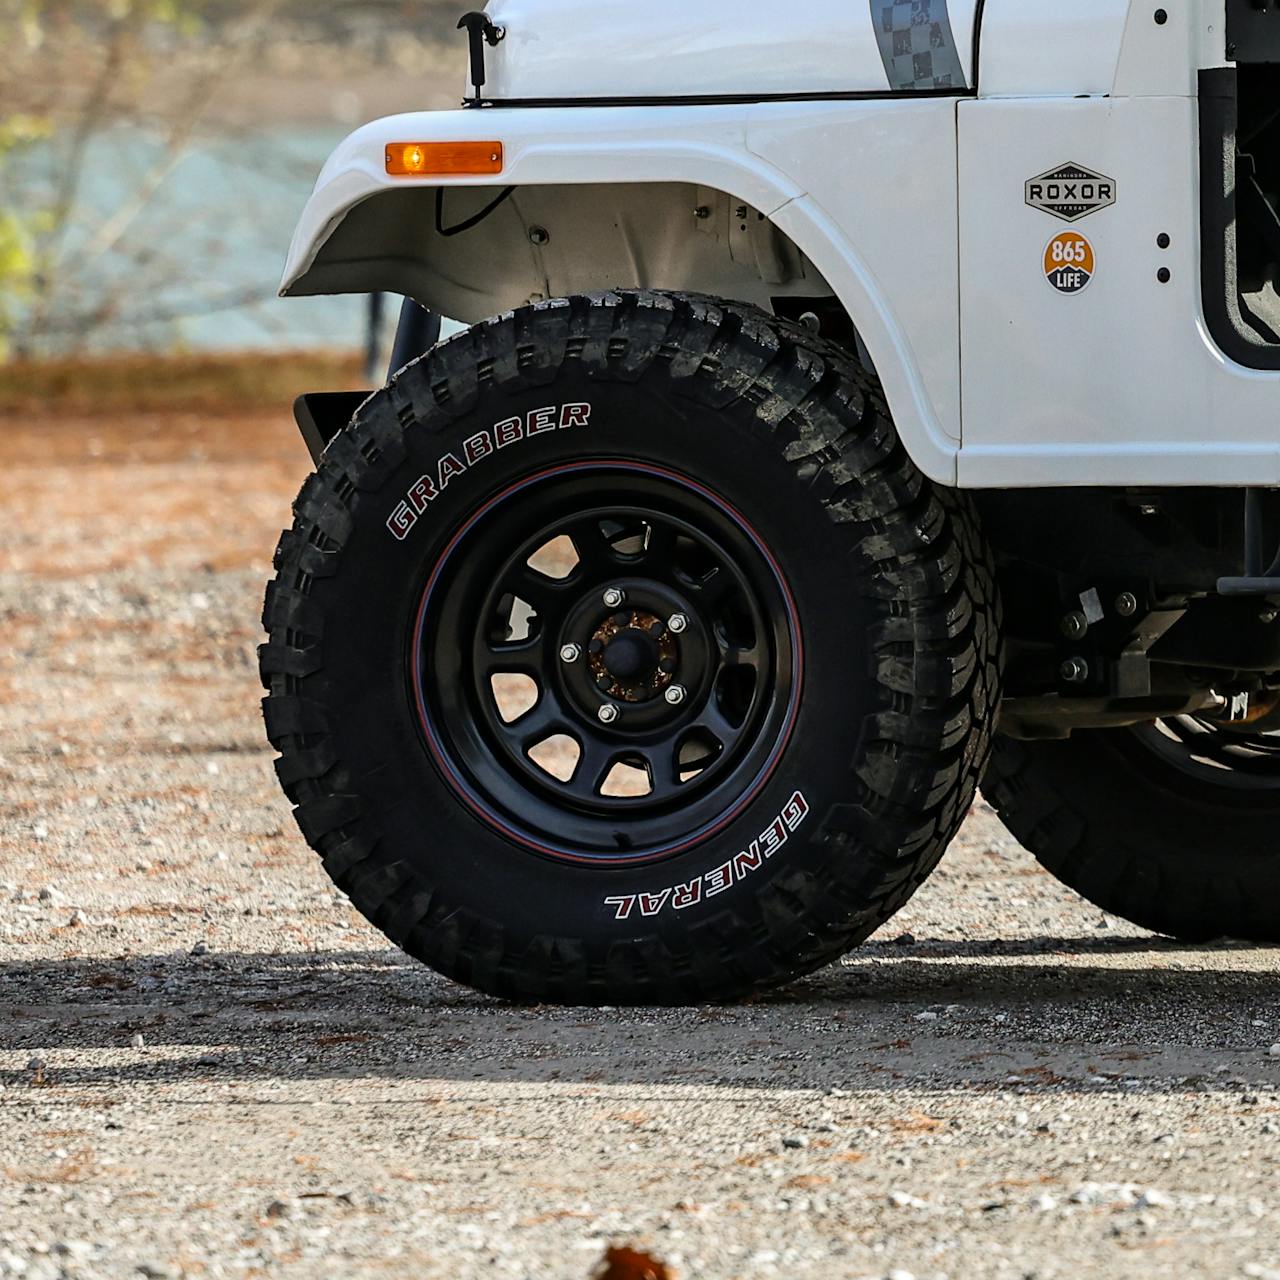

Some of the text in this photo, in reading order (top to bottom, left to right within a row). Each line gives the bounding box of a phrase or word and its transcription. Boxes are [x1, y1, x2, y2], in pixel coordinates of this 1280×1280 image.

[1030, 183, 1111, 200] ROXOR
[1051, 240, 1086, 263] 865
[1056, 272, 1081, 288] LIFE
[386, 402, 591, 540] GRABBER
[604, 790, 810, 920] GENERAL
